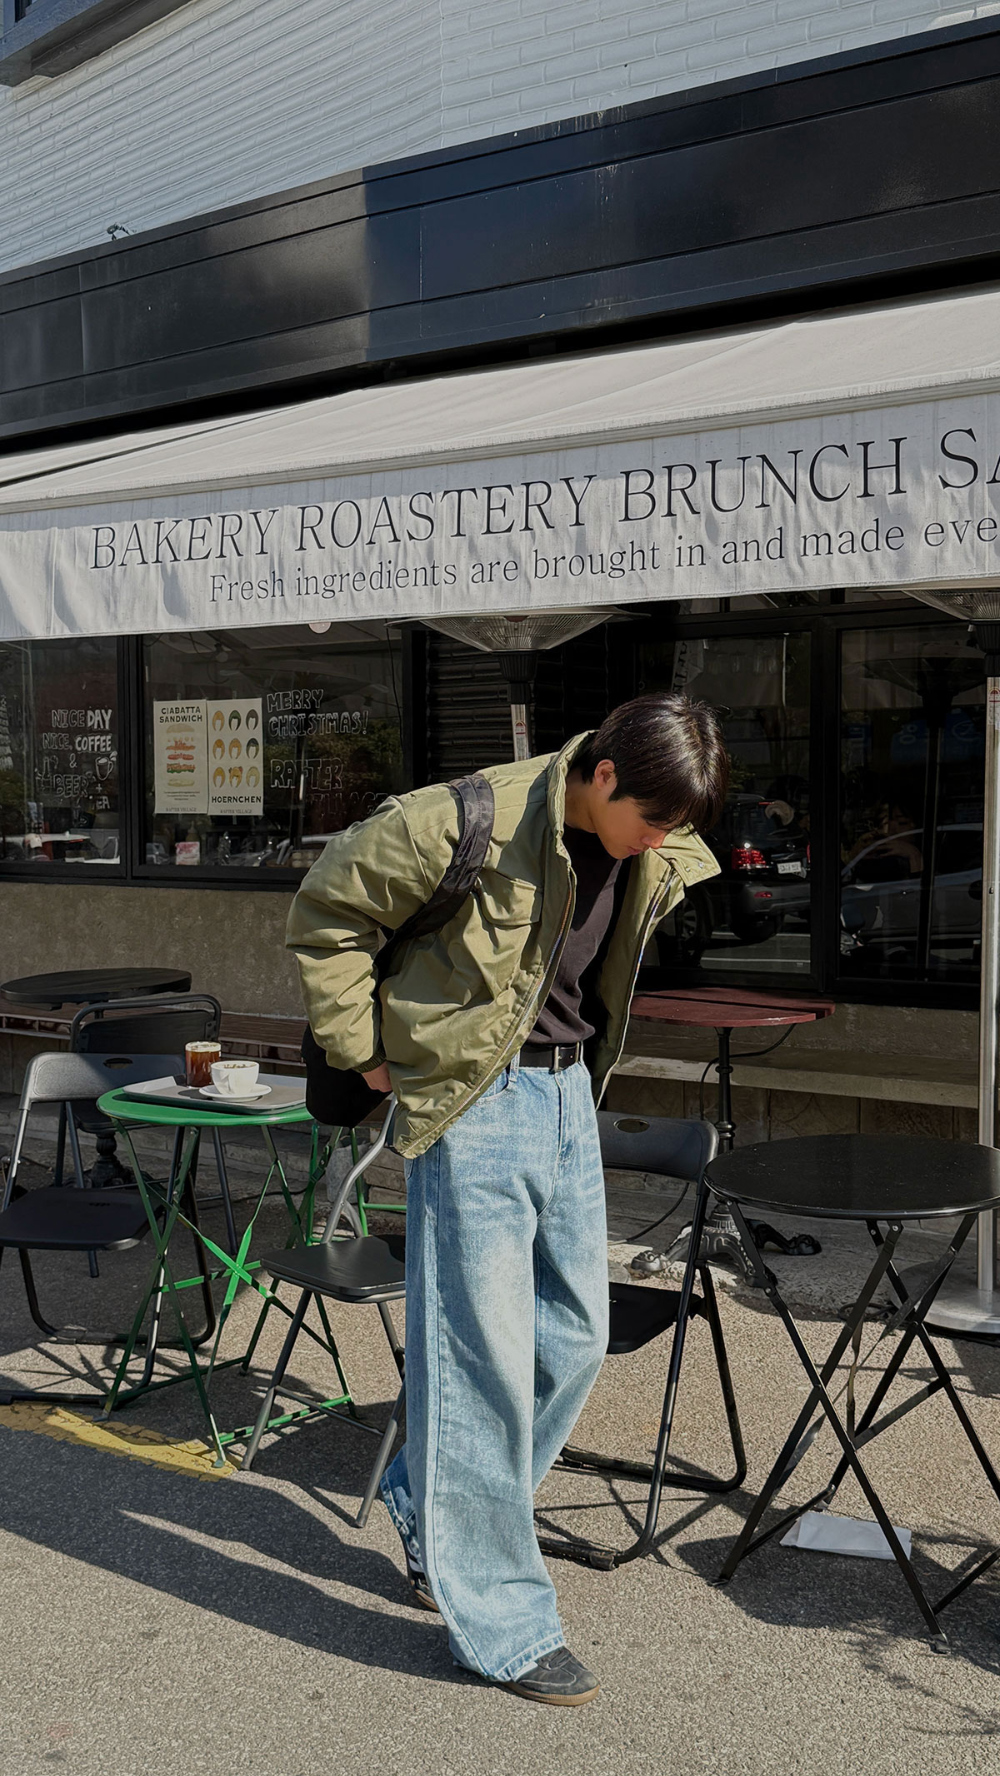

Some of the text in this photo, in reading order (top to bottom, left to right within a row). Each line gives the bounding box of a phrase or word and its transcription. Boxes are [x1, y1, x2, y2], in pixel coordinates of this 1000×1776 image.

[90, 508, 279, 570] BAKERY
[295, 474, 597, 552] ROASTERY
[618, 437, 907, 523] BRUNCH
[210, 572, 285, 602] Fresh
[295, 559, 457, 599] ingredients
[470, 562, 519, 584] are
[533, 540, 661, 580] brought
[674, 535, 706, 568] in
[722, 527, 785, 565] and
[800, 518, 905, 557] made
[161, 706, 201, 715] CIABATTA
[267, 689, 323, 712] MERRY
[52, 709, 112, 729] NICE DAY
[159, 715, 203, 724] SANDWICH
[268, 710, 369, 738] CHRISTMAS!
[75, 735, 112, 752] COFFEE
[69, 753, 78, 769] &
[54, 774, 88, 797] BEER
[211, 796, 262, 804] HOERNCHEN
